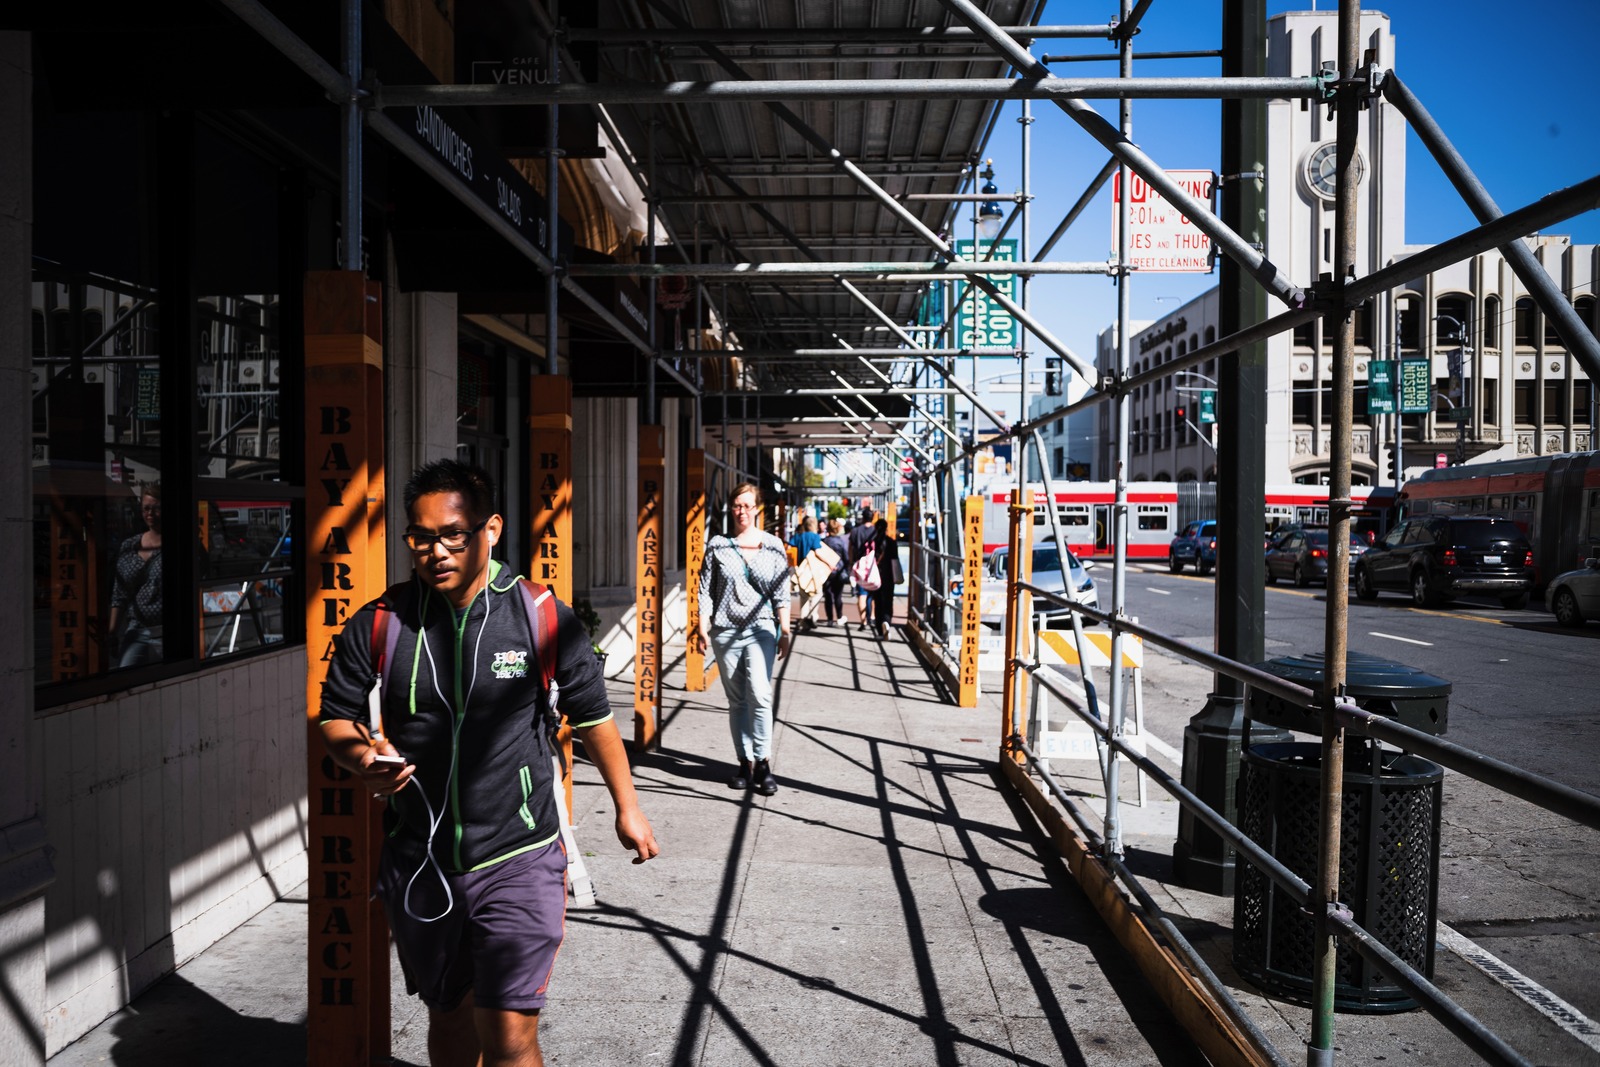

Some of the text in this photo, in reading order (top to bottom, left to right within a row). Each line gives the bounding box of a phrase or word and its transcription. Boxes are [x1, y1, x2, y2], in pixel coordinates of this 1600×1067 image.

[512, 57, 540, 66] CAFE
[415, 105, 474, 182] SANDWICHES
[497, 176, 522, 227] SALADS
[1149, 180, 1212, 199] PING
[1130, 233, 1152, 249] UES
[1174, 233, 1210, 249] THUR
[1130, 256, 1206, 268] TREET CLEANING
[1403, 365, 1416, 407] BABSON
[1416, 364, 1428, 407] COLLEGE
[319, 406, 352, 507] BAY
[540, 452, 559, 511] BAY
[691, 525, 701, 562] AREA
[639, 480, 658, 702] BAY AREA HIGH REACH
[964, 515, 980, 685] BAY AREA HIGH REACH
[493, 650, 528, 664] HOT
[319, 836, 356, 1006] REACH
[1513, 985, 1600, 1036] PASSENGER
